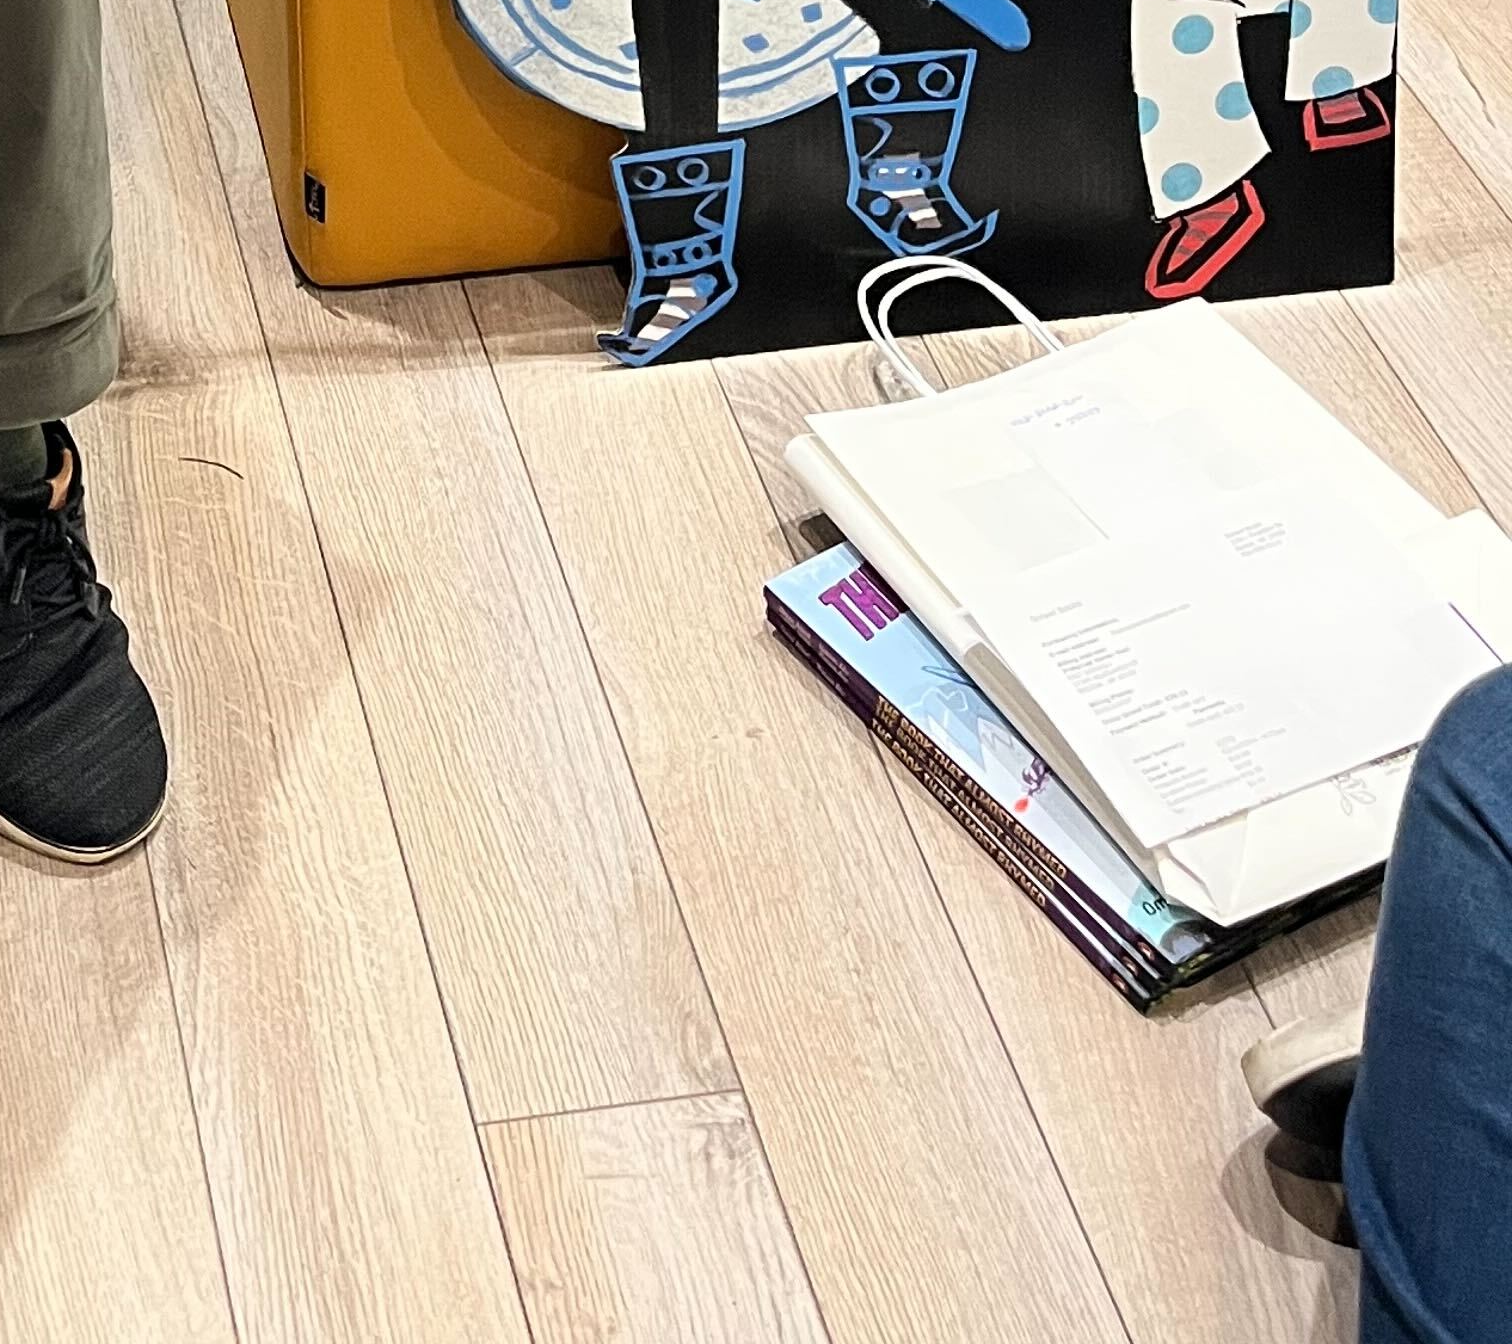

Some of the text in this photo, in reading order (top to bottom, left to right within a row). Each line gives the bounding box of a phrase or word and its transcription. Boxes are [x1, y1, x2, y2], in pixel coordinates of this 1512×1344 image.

[897, 717, 934, 753] BOOK
[961, 776, 1015, 828] ALMOST
[1010, 822, 1070, 880] RHYMED
